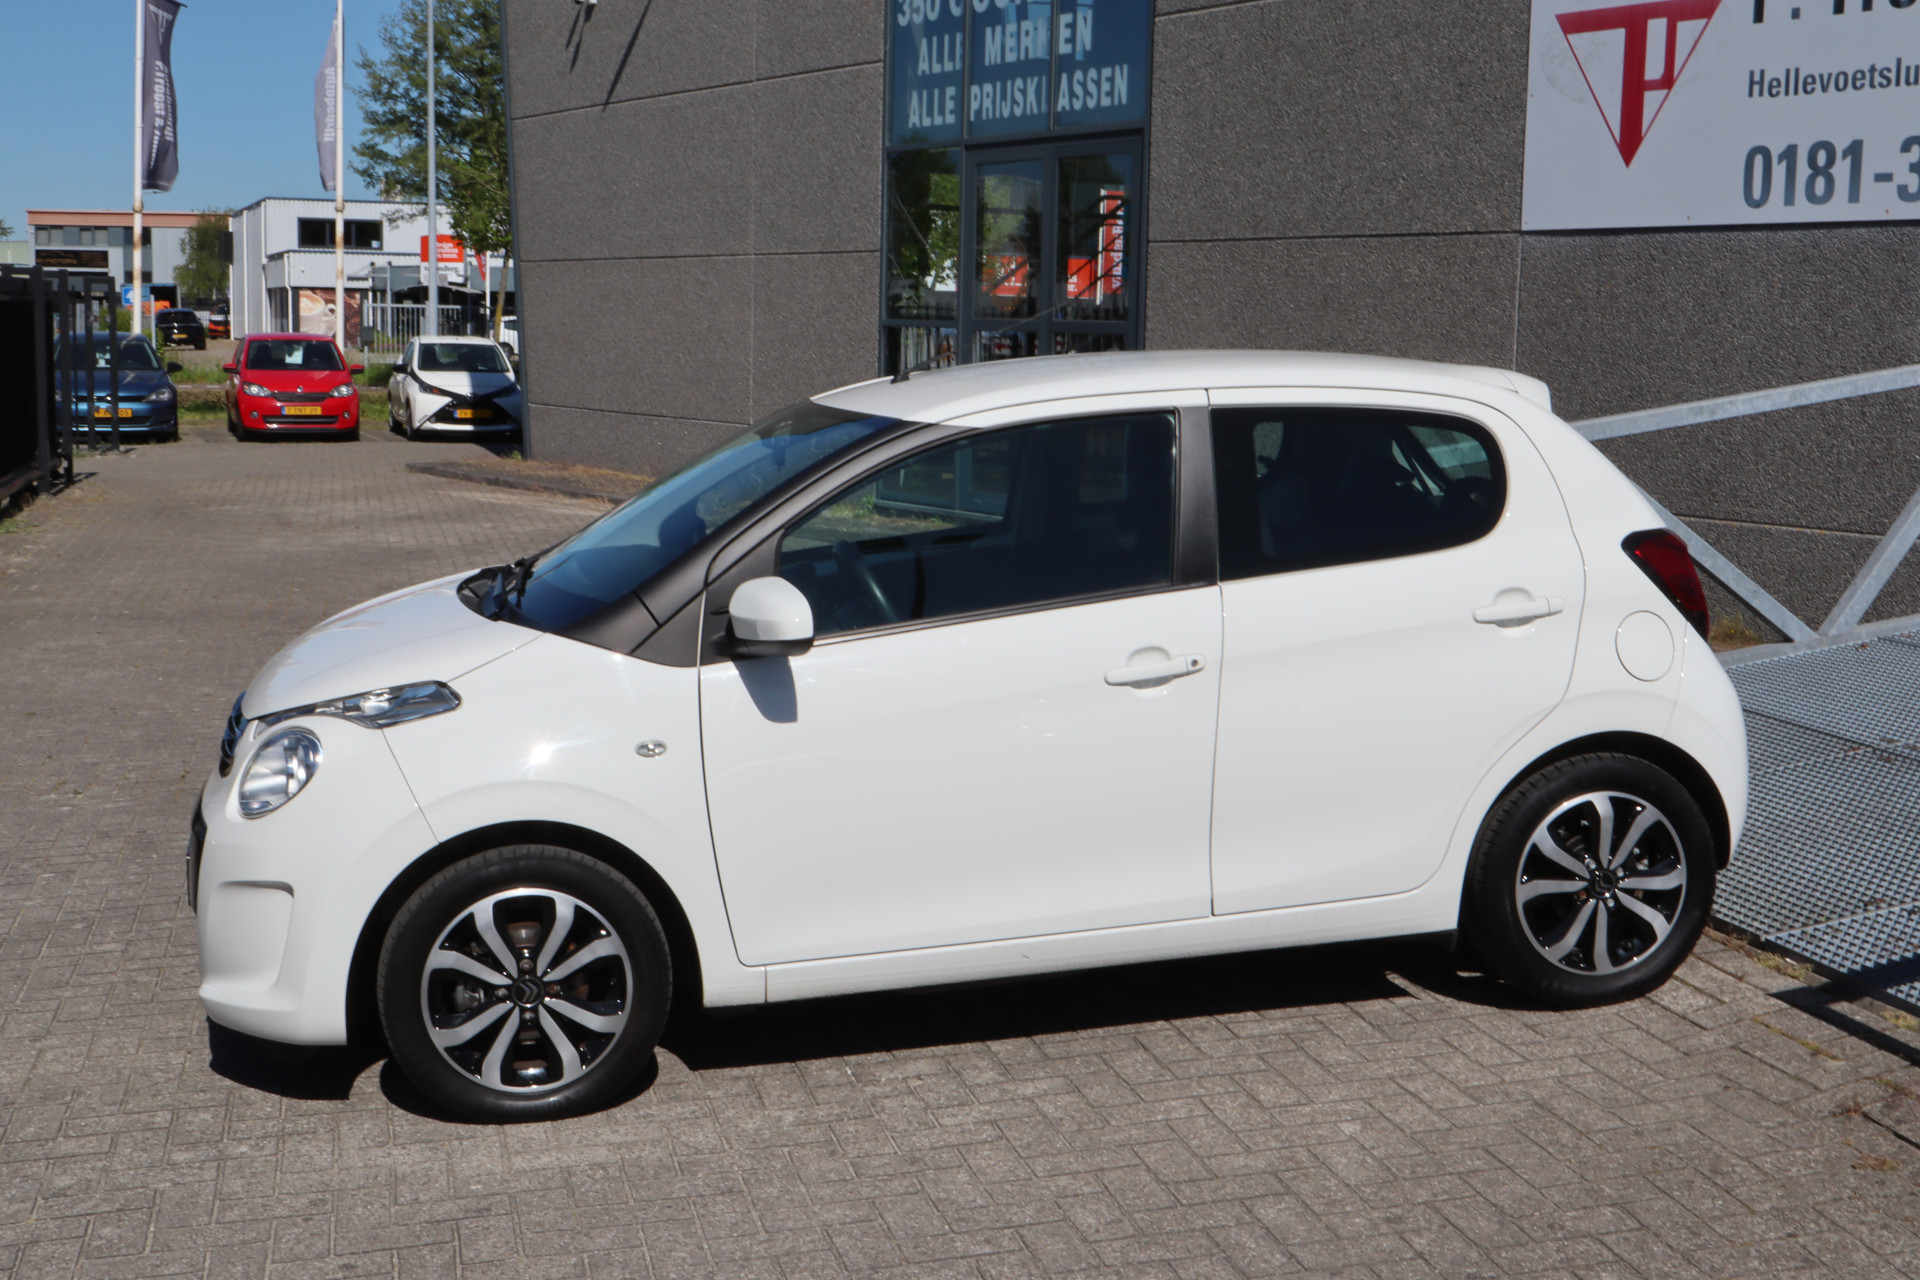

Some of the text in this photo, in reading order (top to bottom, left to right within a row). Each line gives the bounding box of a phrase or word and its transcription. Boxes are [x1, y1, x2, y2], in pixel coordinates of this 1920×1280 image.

[1748, 57, 1920, 98] Hellevoetslu
[908, 86, 956, 128] ALLE
[1743, 135, 1920, 209] 0181-3
